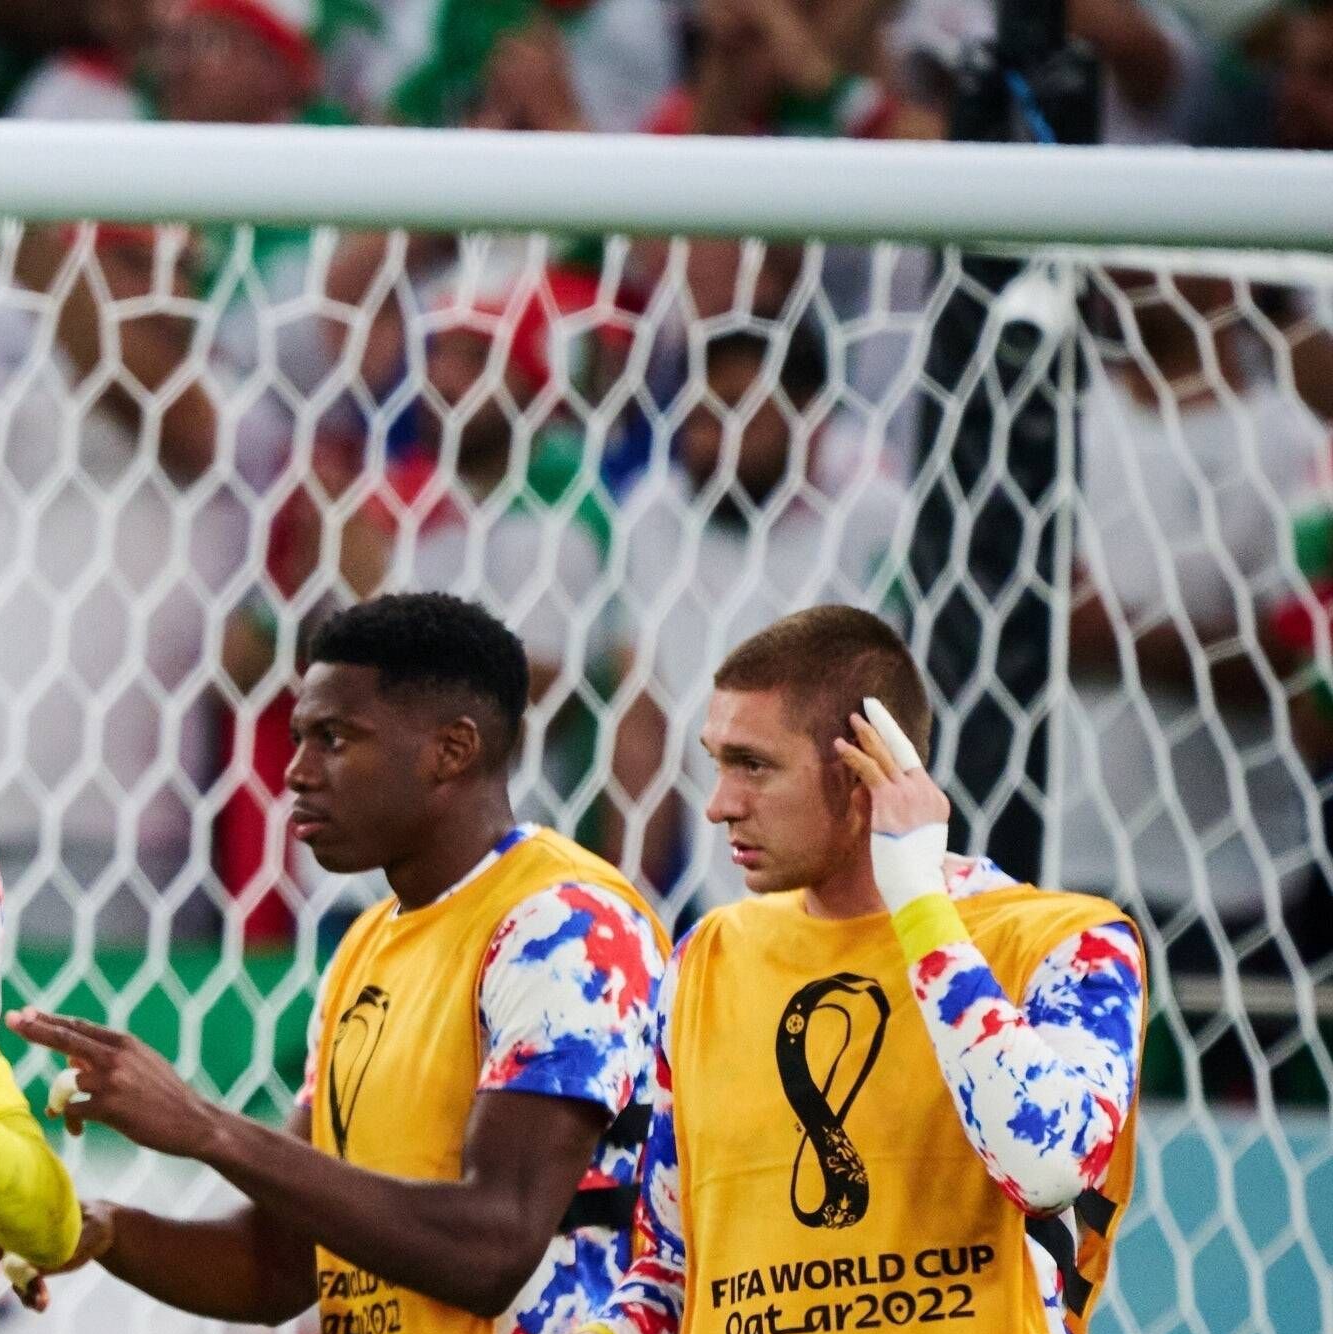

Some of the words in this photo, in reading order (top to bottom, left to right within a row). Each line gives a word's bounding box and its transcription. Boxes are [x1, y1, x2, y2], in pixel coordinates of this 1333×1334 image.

[711, 1268, 766, 1309] FIFA
[769, 1253, 906, 1294] WORLD
[914, 1244, 995, 1279] CUP
